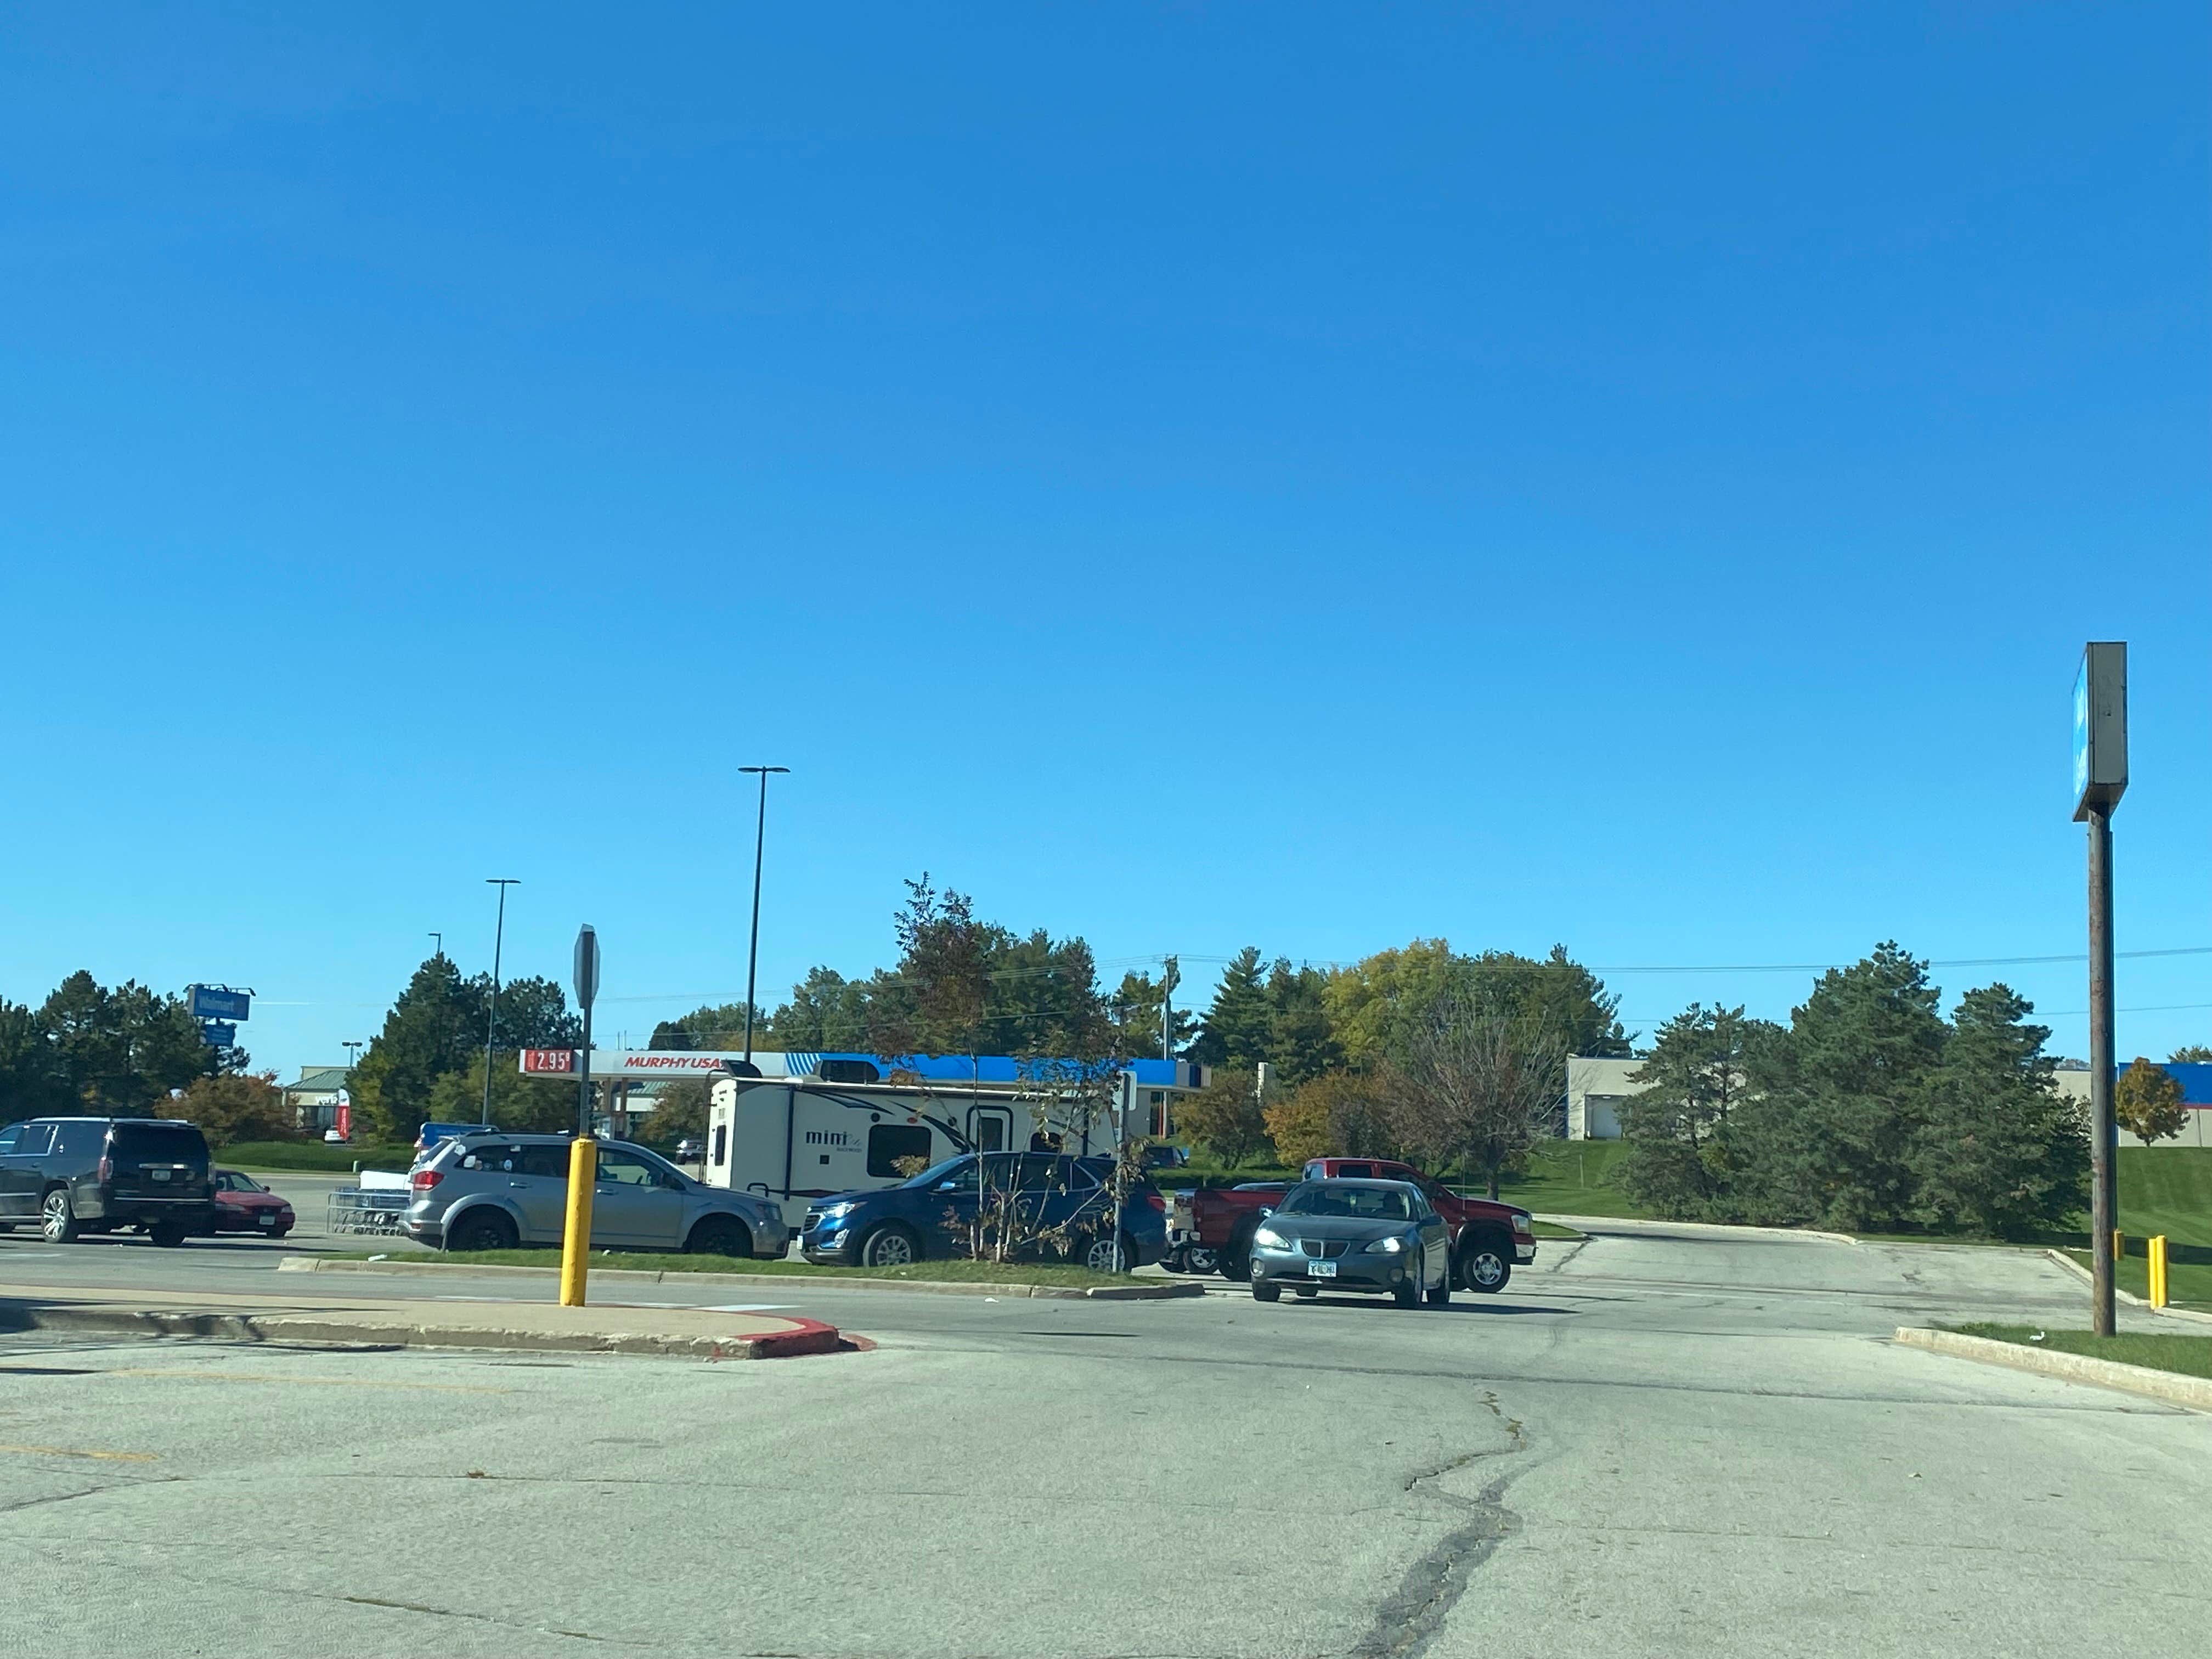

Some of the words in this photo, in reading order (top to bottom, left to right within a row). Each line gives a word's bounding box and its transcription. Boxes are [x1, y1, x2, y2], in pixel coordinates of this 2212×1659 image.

[624, 1057, 690, 1068] MURPHY
[691, 1058, 720, 1068] USA
[806, 1130, 847, 1146] mini
